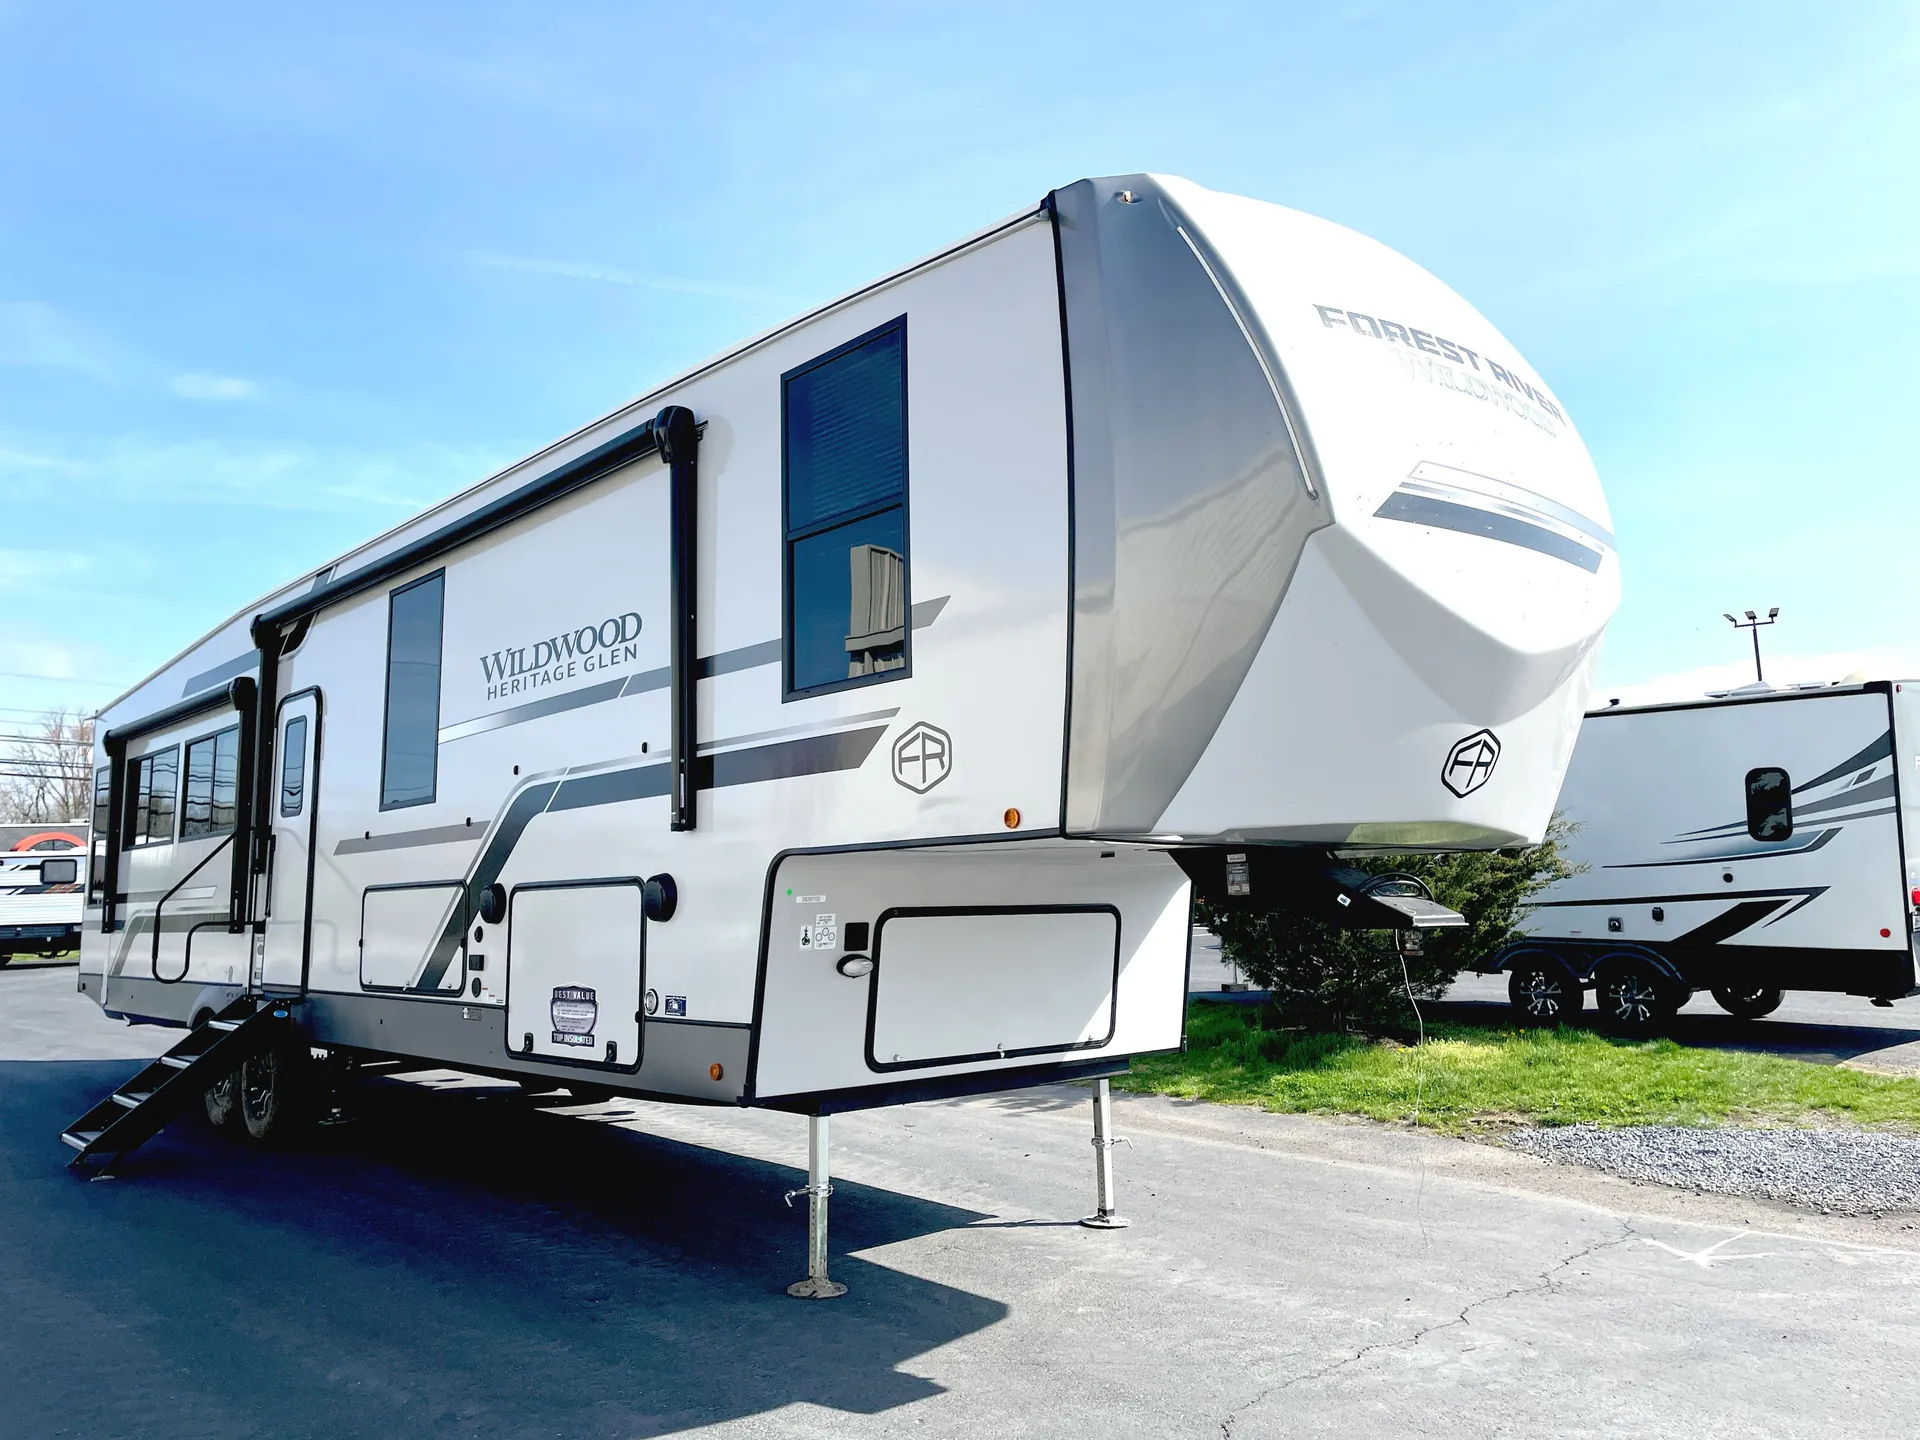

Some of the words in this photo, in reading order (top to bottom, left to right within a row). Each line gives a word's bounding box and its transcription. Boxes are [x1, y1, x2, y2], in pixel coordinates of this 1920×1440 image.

[1312, 303, 1480, 372] FOREST
[1484, 357, 1567, 428] RIVER
[480, 612, 642, 684] WILDWOOD
[487, 661, 577, 701] HERITAGE
[584, 643, 637, 672] GLEN
[554, 990, 570, 999] BEST
[573, 991, 594, 1000] VALUE
